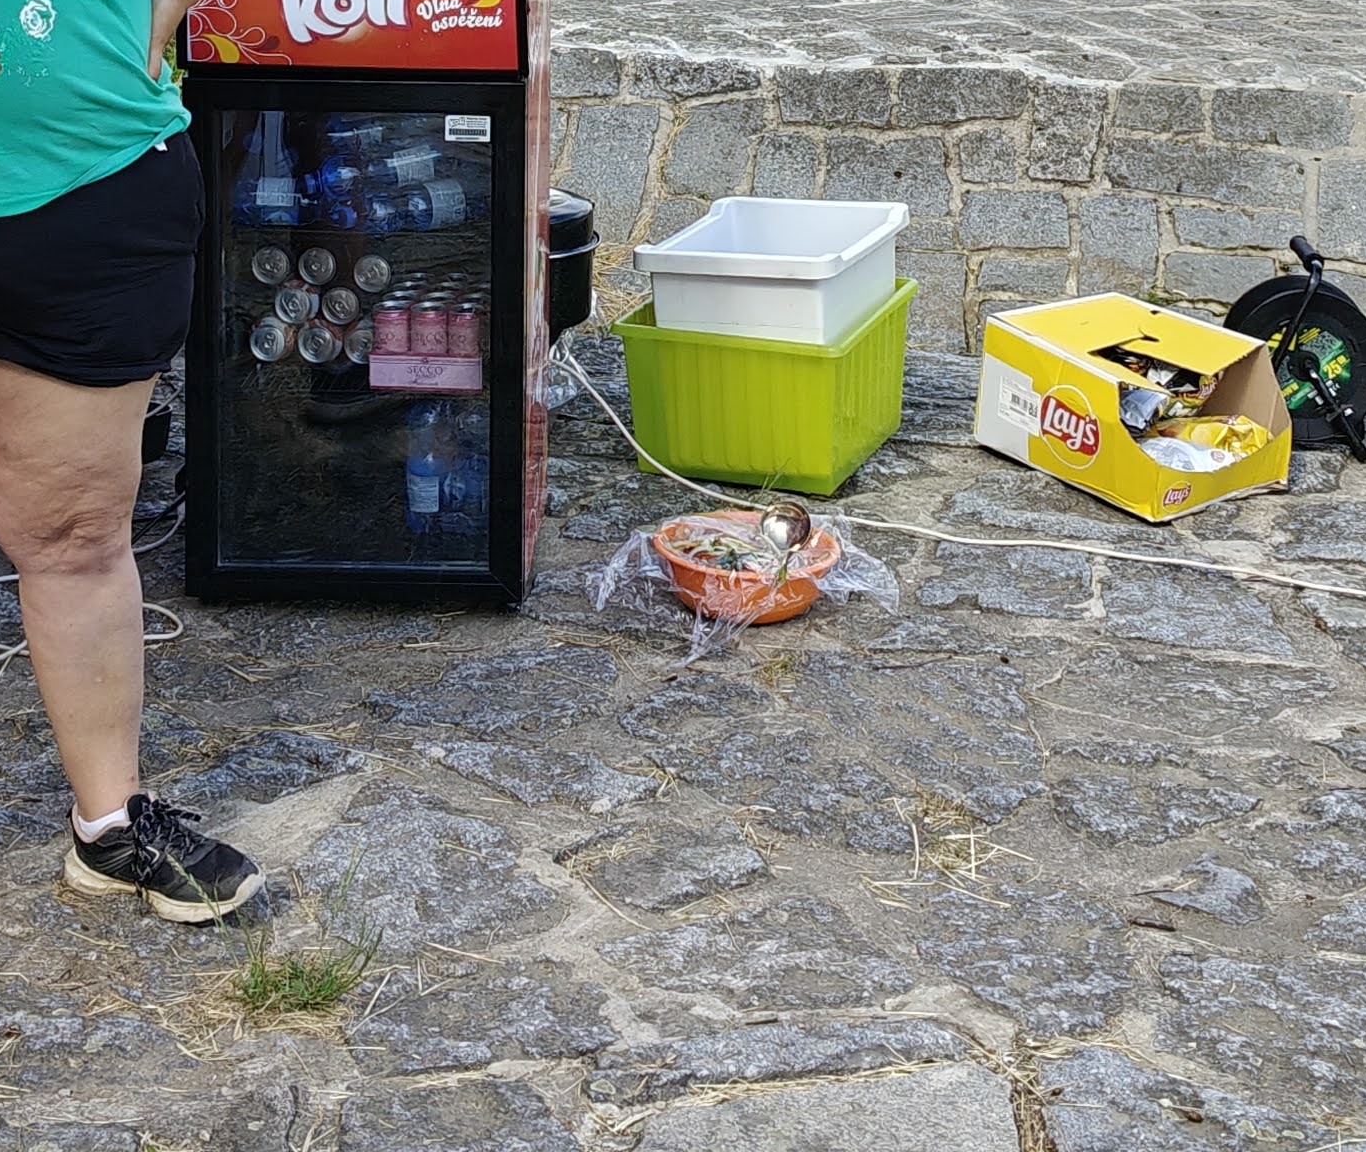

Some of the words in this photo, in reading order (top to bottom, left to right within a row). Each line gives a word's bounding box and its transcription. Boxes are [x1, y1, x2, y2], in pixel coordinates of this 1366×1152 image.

[430, 6, 504, 34] osvěžení
[406, 365, 444, 376] SECCO
[1042, 397, 1098, 451] Lay's
[1164, 483, 1192, 505] Lay's
